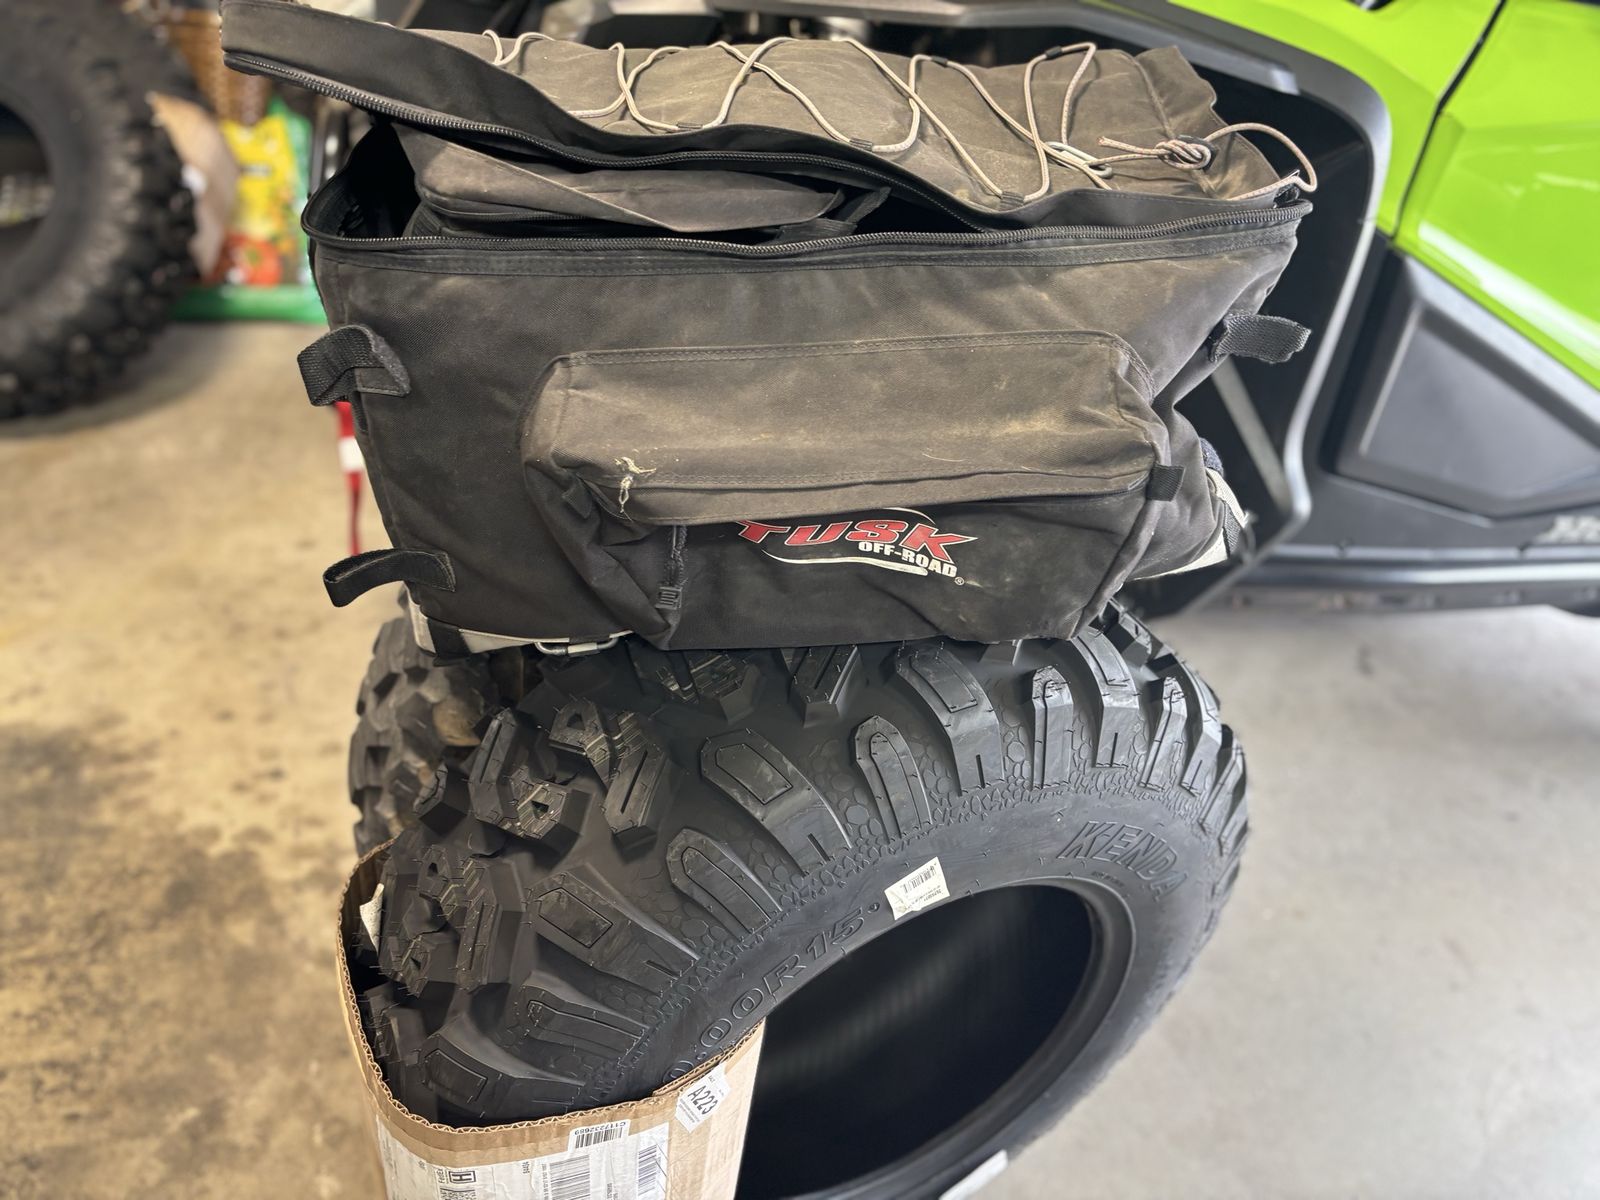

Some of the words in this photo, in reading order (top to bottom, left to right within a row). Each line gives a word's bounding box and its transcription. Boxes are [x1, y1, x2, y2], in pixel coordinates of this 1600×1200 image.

[736, 519, 979, 564] TUSK
[858, 541, 957, 578] OFF-ROAD
[1056, 821, 1188, 902] KENDA
[687, 1085, 718, 1115] A223
